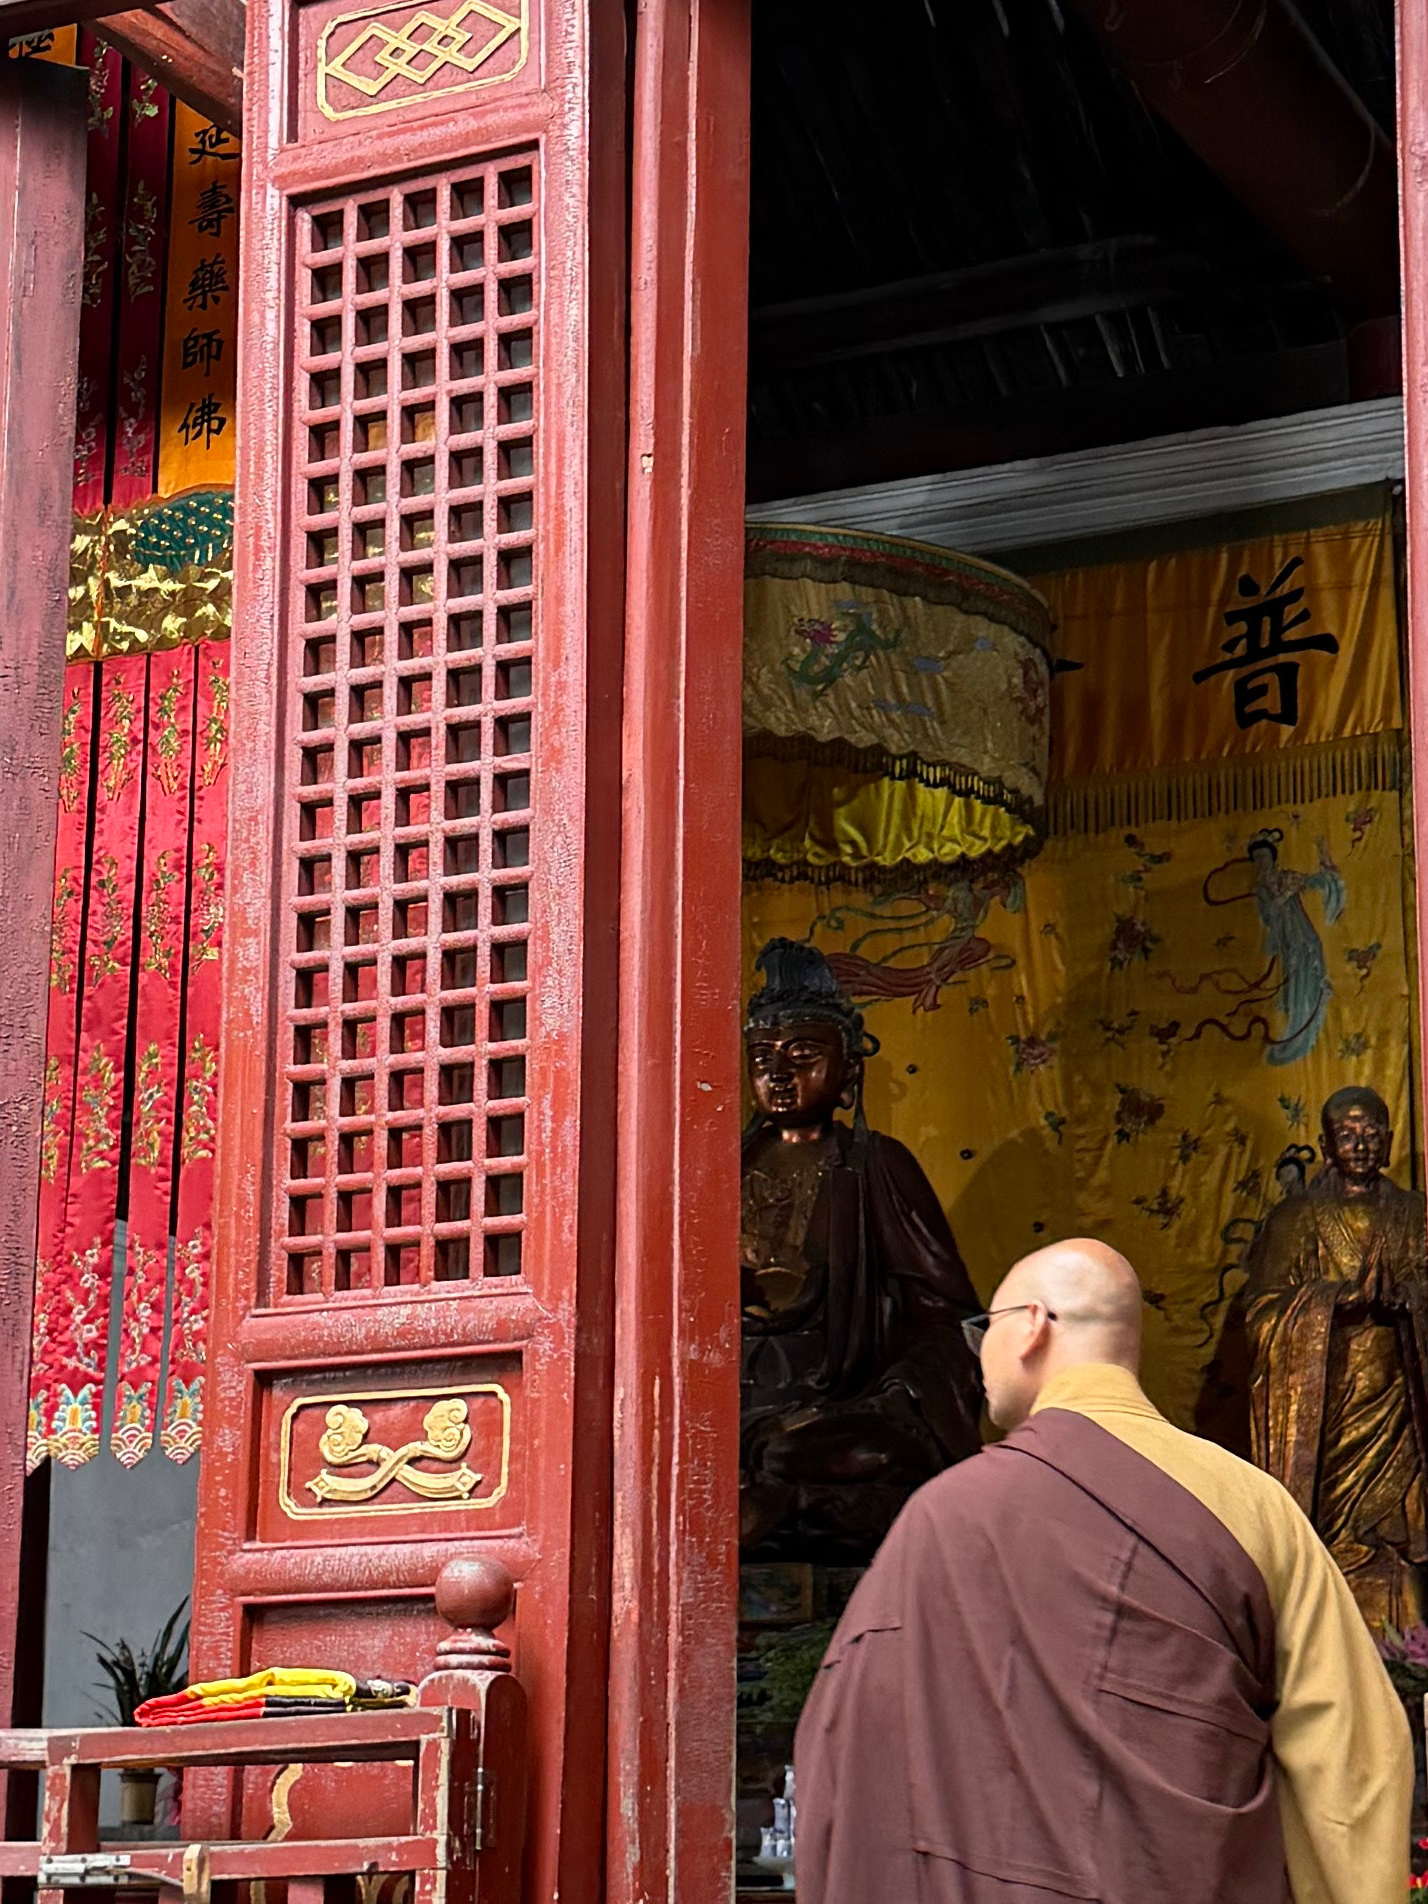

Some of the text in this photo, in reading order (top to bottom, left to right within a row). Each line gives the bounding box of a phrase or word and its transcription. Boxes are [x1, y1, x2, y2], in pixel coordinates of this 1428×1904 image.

[177, 123, 240, 451] 延壽藥師佛
[1191, 555, 1340, 731] 普
